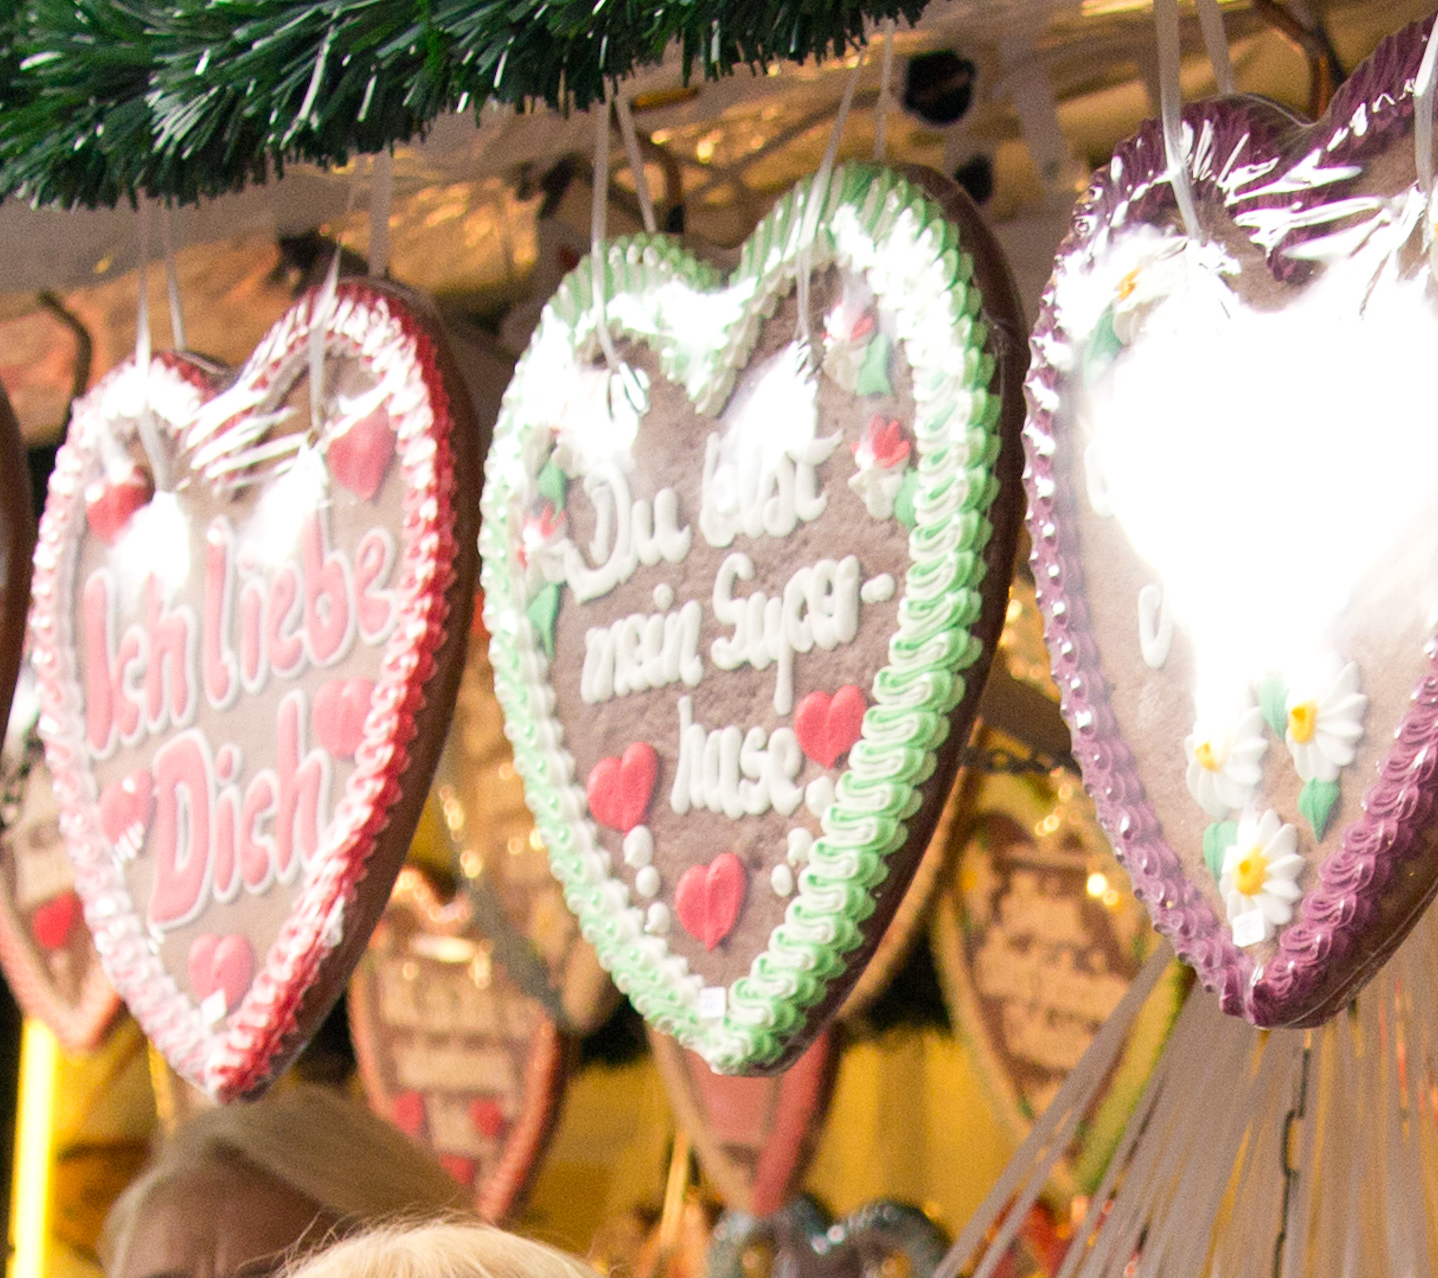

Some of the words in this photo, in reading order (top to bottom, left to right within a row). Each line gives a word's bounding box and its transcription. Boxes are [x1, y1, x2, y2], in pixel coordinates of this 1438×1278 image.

[560, 463, 691, 600] Du
[697, 428, 844, 547] bist
[84, 566, 196, 762] Ich
[200, 516, 403, 712] liebe
[581, 580, 704, 704] mein
[147, 689, 327, 930] Dich
